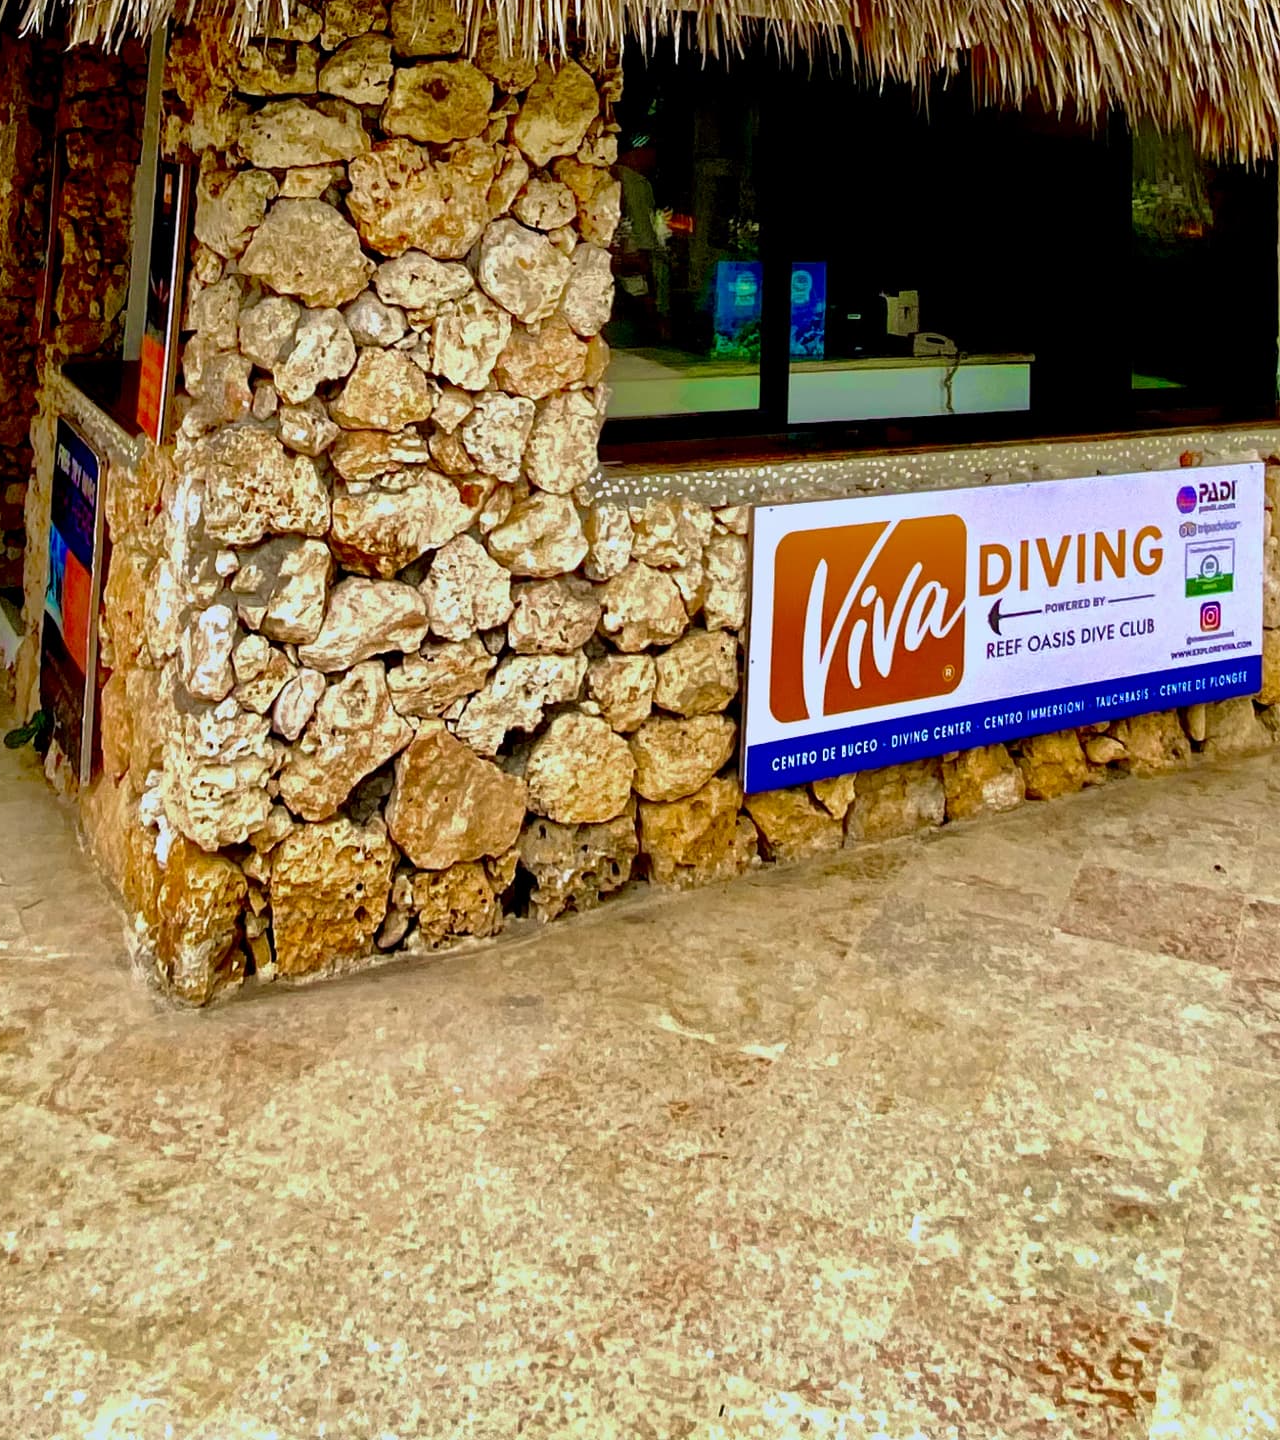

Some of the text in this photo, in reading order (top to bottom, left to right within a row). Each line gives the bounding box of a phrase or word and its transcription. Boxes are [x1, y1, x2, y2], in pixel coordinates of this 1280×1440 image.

[1199, 480, 1236, 503] PADI
[978, 525, 1164, 597] DIVING
[803, 519, 966, 719] Viva
[1044, 596, 1106, 614] POWERED BY
[986, 618, 1155, 659] REEF OASIS DIVE CLUB
[771, 750, 817, 772] CENTRO
[822, 746, 836, 762] DE
[841, 739, 878, 758] BUCEO
[891, 728, 929, 748] DIVING
[933, 721, 971, 739] CENTER
[984, 711, 1023, 729] CENTRO
[1027, 699, 1085, 721] IMMERSIONI
[1096, 688, 1150, 708] TAUCHBASIS
[1159, 681, 1192, 697] CENTRE
[1195, 678, 1206, 690] DE
